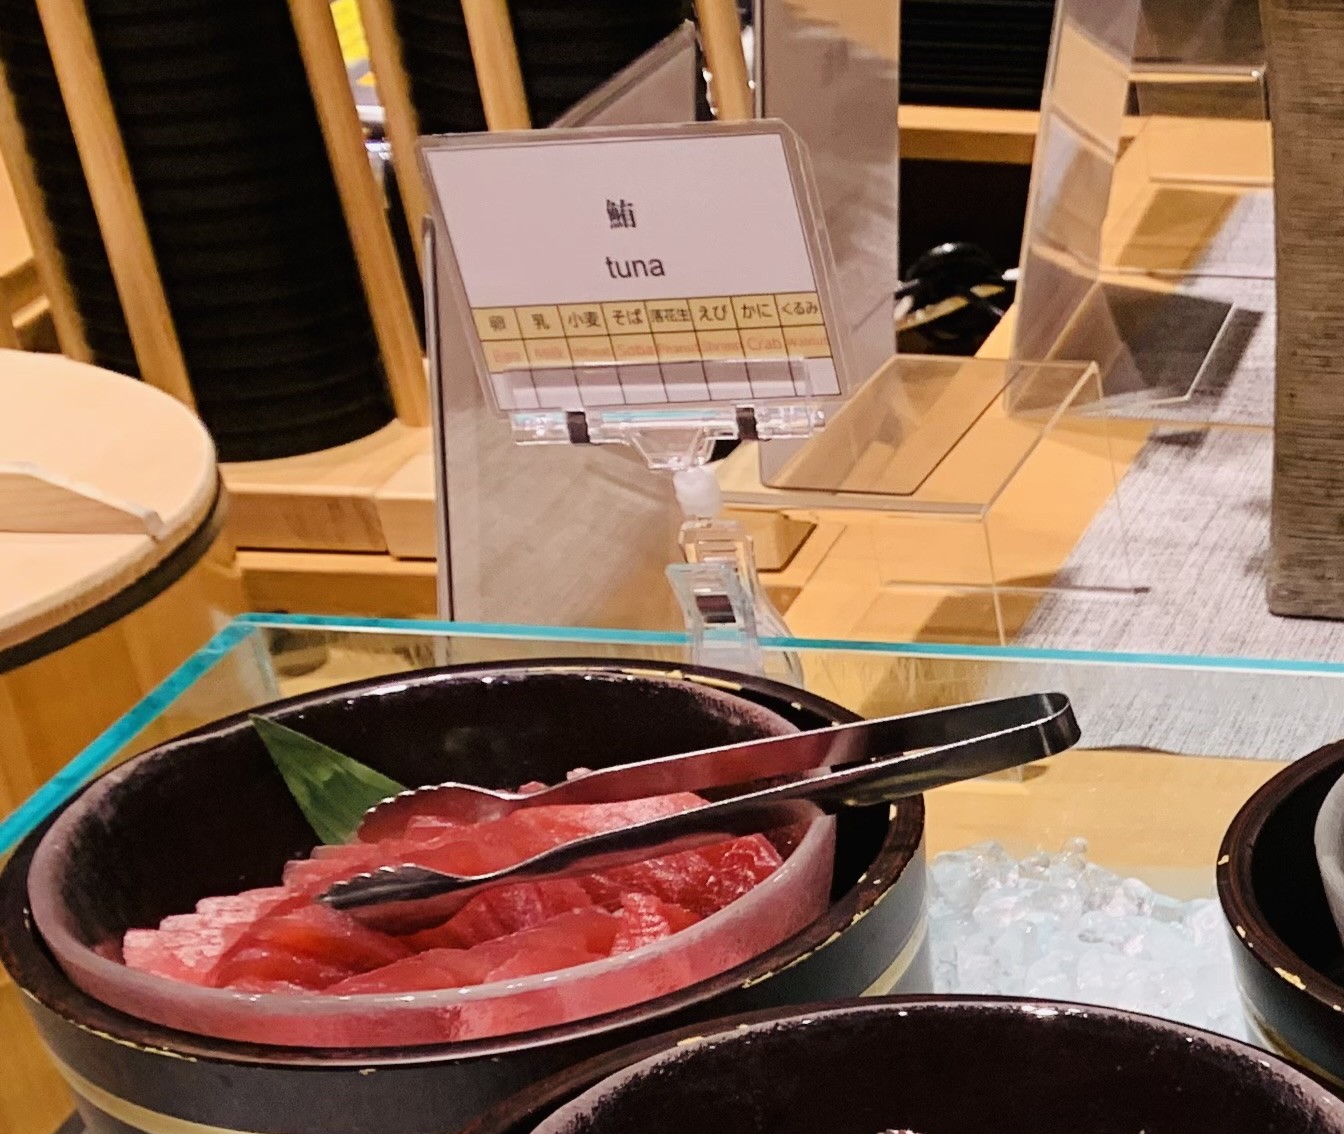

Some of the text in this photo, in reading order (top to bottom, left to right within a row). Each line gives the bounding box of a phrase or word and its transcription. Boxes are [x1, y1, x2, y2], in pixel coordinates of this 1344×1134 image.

[606, 256, 666, 279] tuna
[568, 310, 600, 328] 小麦
[699, 304, 728, 322] えび
[740, 302, 773, 320] かに
[781, 301, 818, 317] くるみ
